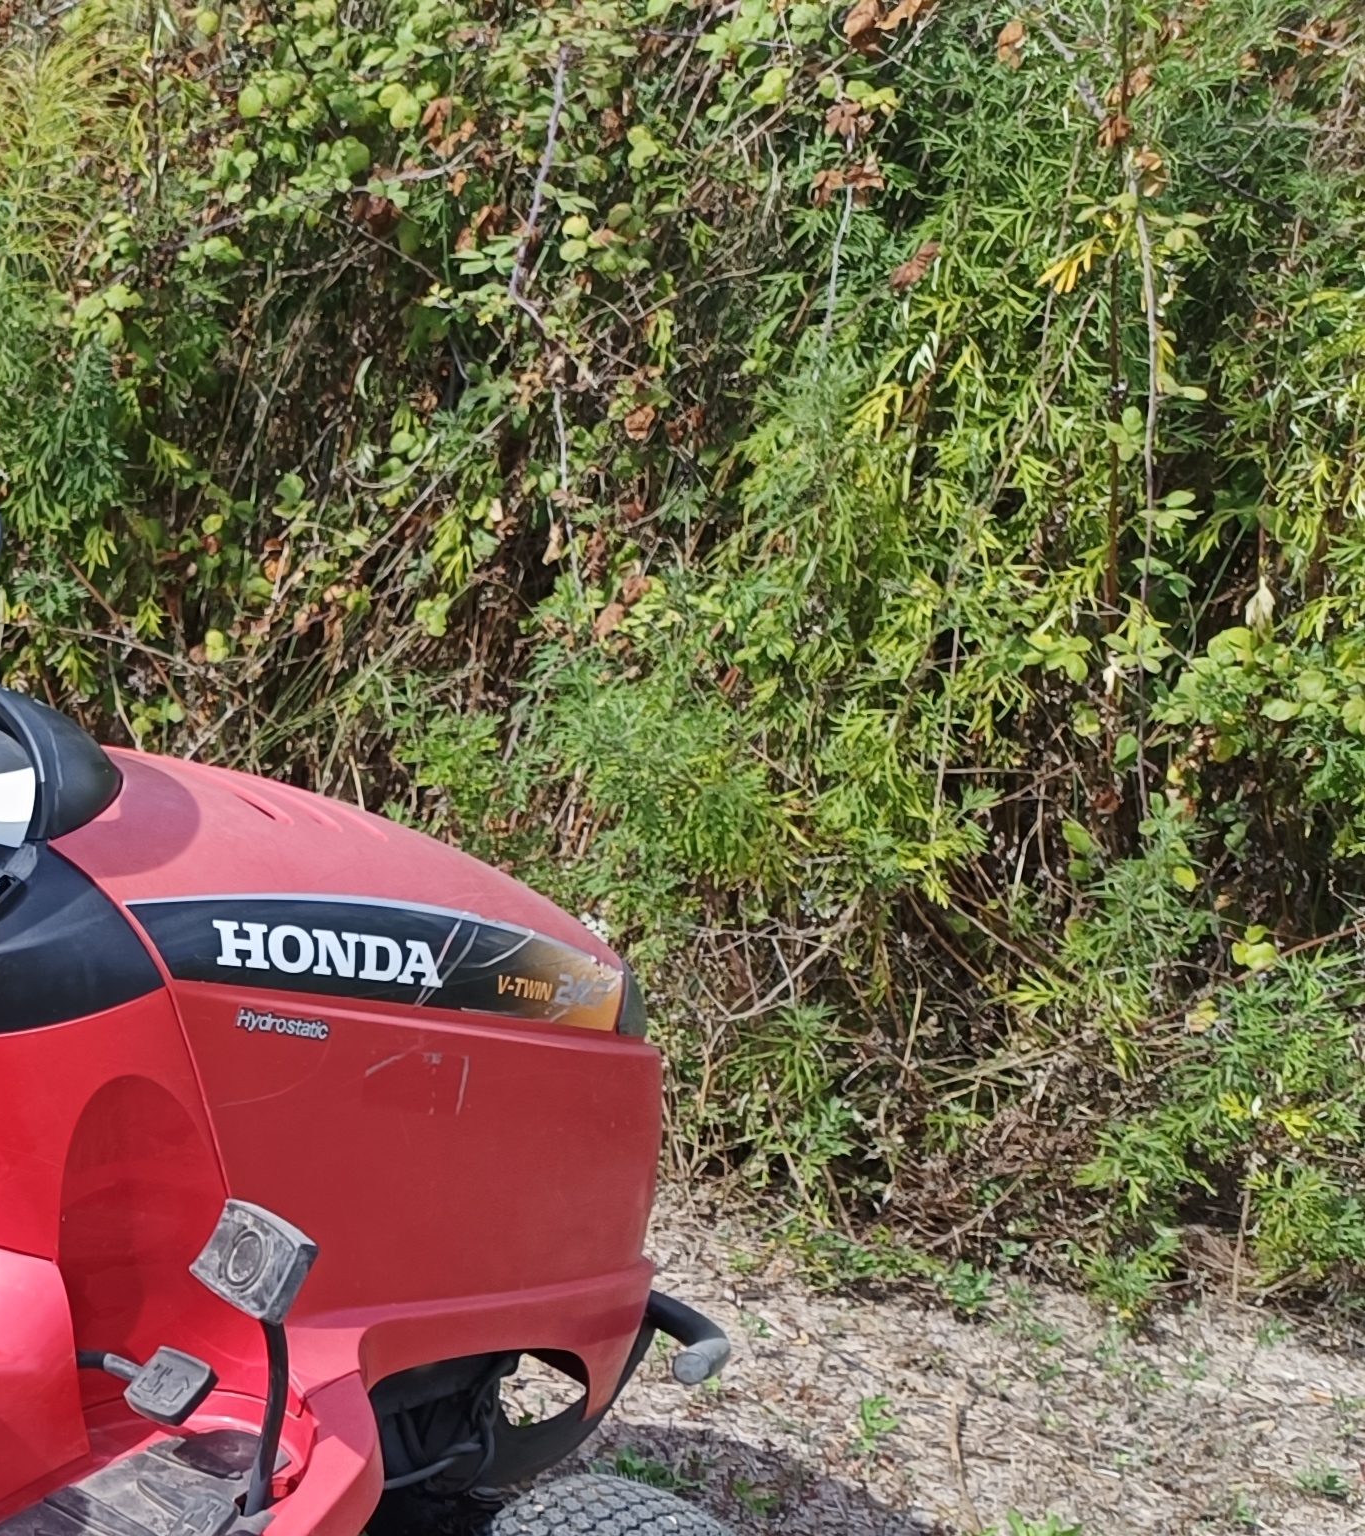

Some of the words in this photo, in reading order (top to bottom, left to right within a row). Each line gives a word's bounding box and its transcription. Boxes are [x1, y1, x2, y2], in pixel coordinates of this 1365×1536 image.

[212, 918, 443, 988] HONDA
[497, 974, 553, 1001] V-TWIN
[236, 1008, 329, 1040] Hydrostatic
